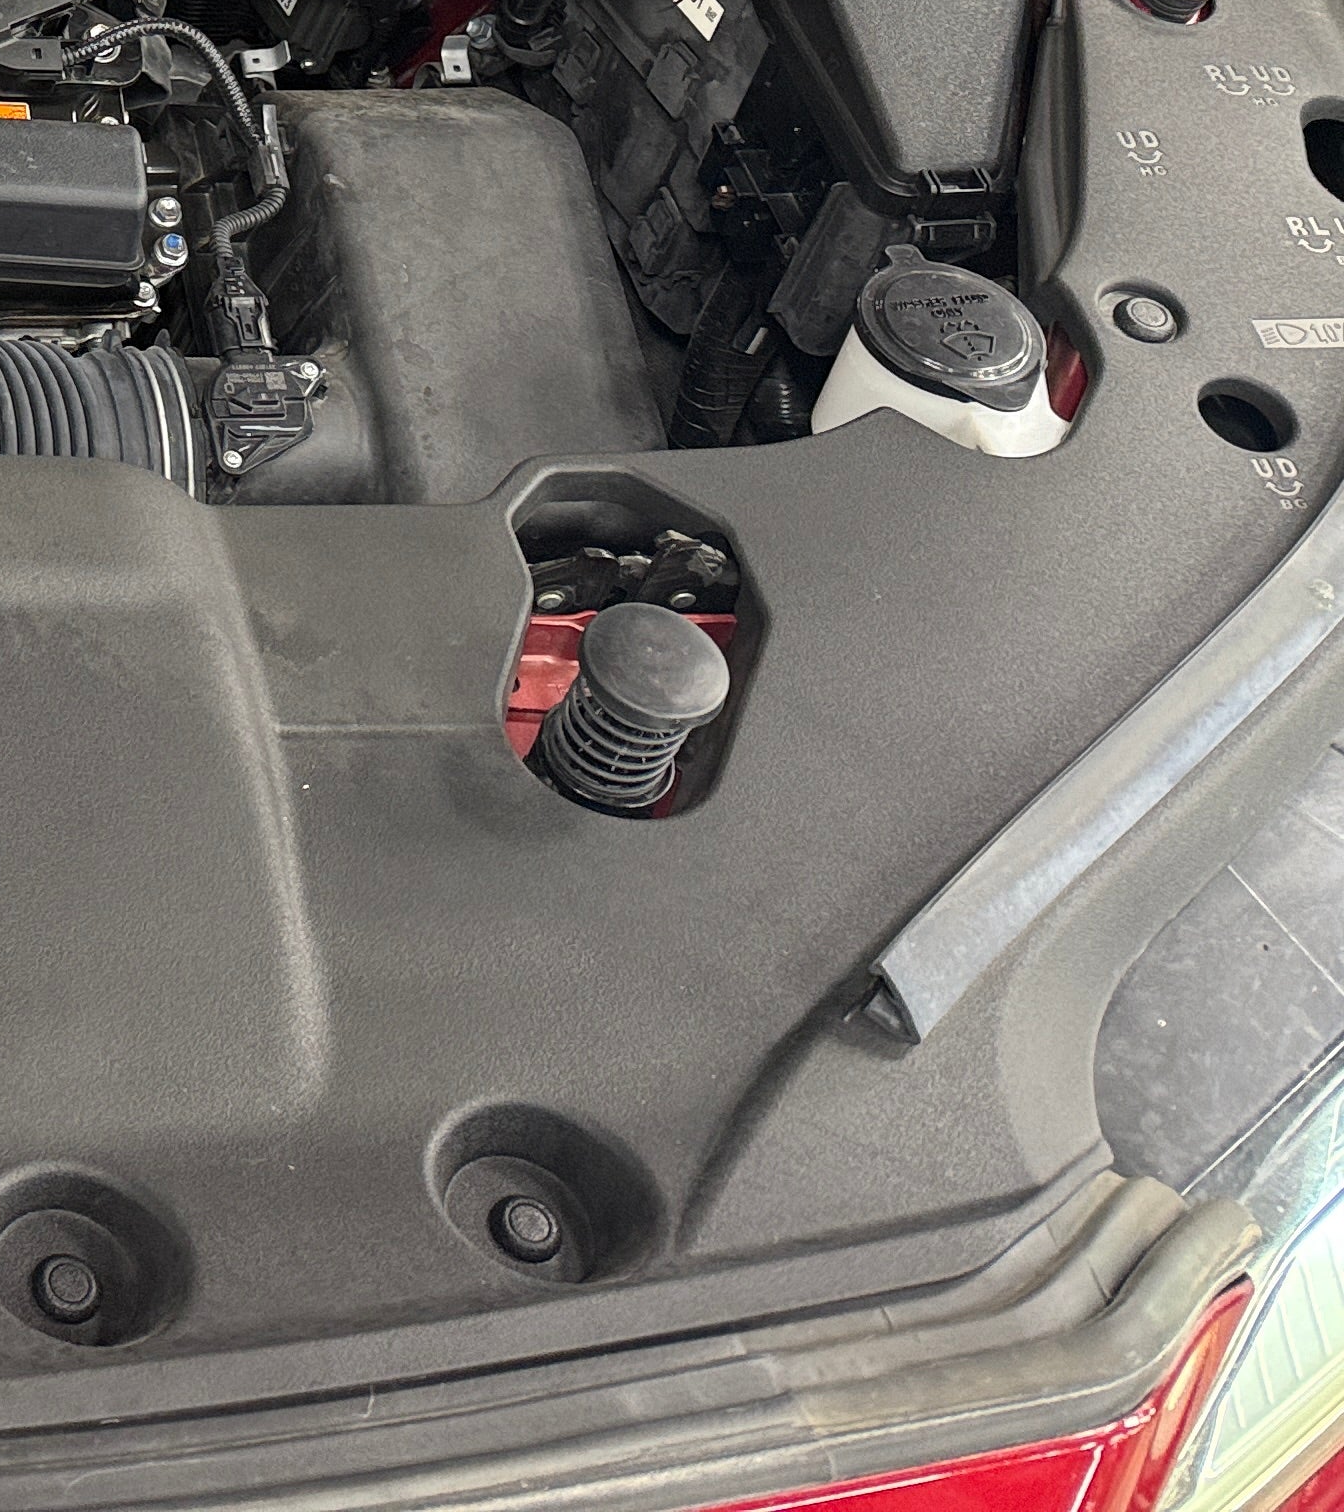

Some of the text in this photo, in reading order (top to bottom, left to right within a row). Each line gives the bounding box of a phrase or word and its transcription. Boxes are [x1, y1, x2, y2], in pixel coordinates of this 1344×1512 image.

[1203, 64, 1292, 83] RL UD
[1116, 130, 1161, 149] UD
[1285, 216, 1331, 237] RL
[1251, 457, 1299, 479] UD
